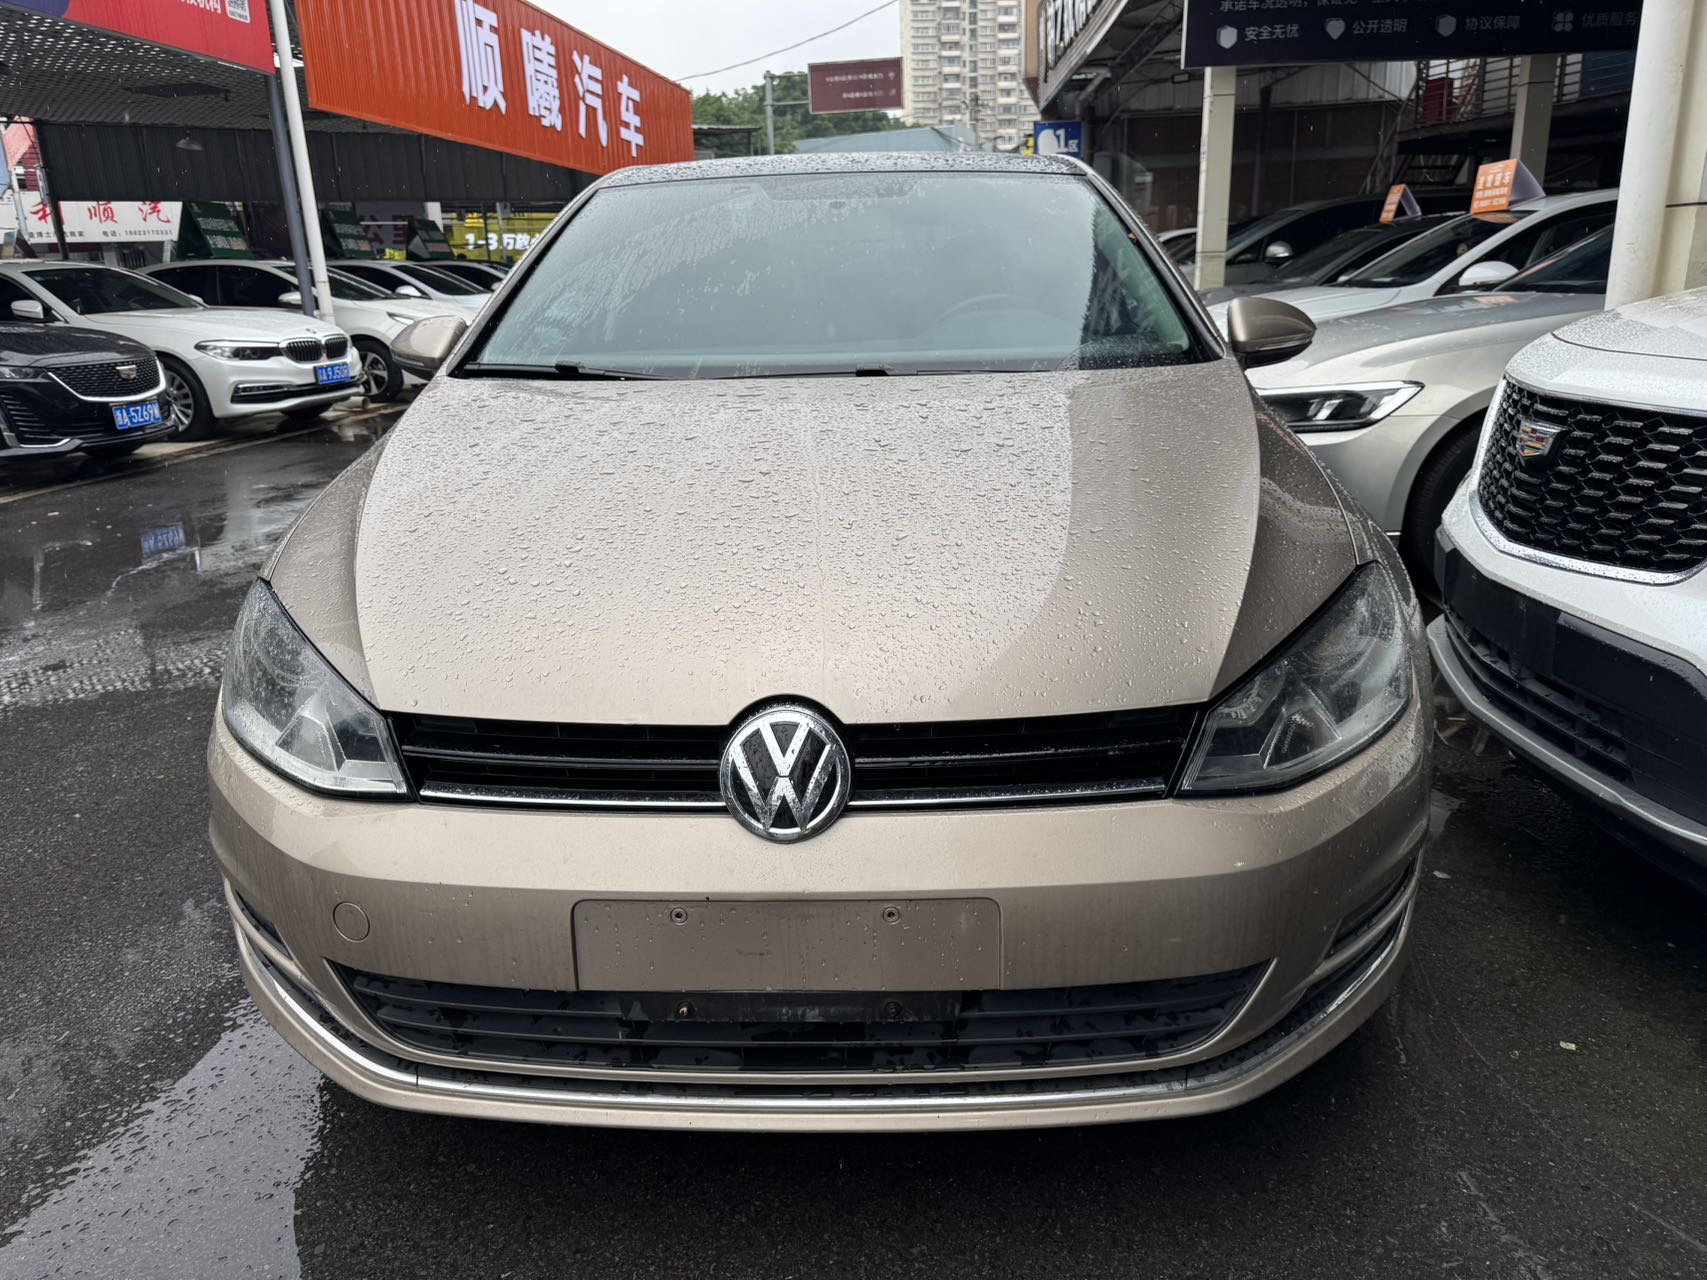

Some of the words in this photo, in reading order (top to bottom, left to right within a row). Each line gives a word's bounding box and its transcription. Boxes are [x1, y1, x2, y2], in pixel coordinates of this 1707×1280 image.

[1244, 24, 1300, 41] 安全无忧
[1352, 18, 1408, 35] 公开透明
[1465, 15, 1521, 31] 协议保障
[1582, 11, 1639, 28] 优质服务
[454, 0, 644, 157] 顺曦汽车
